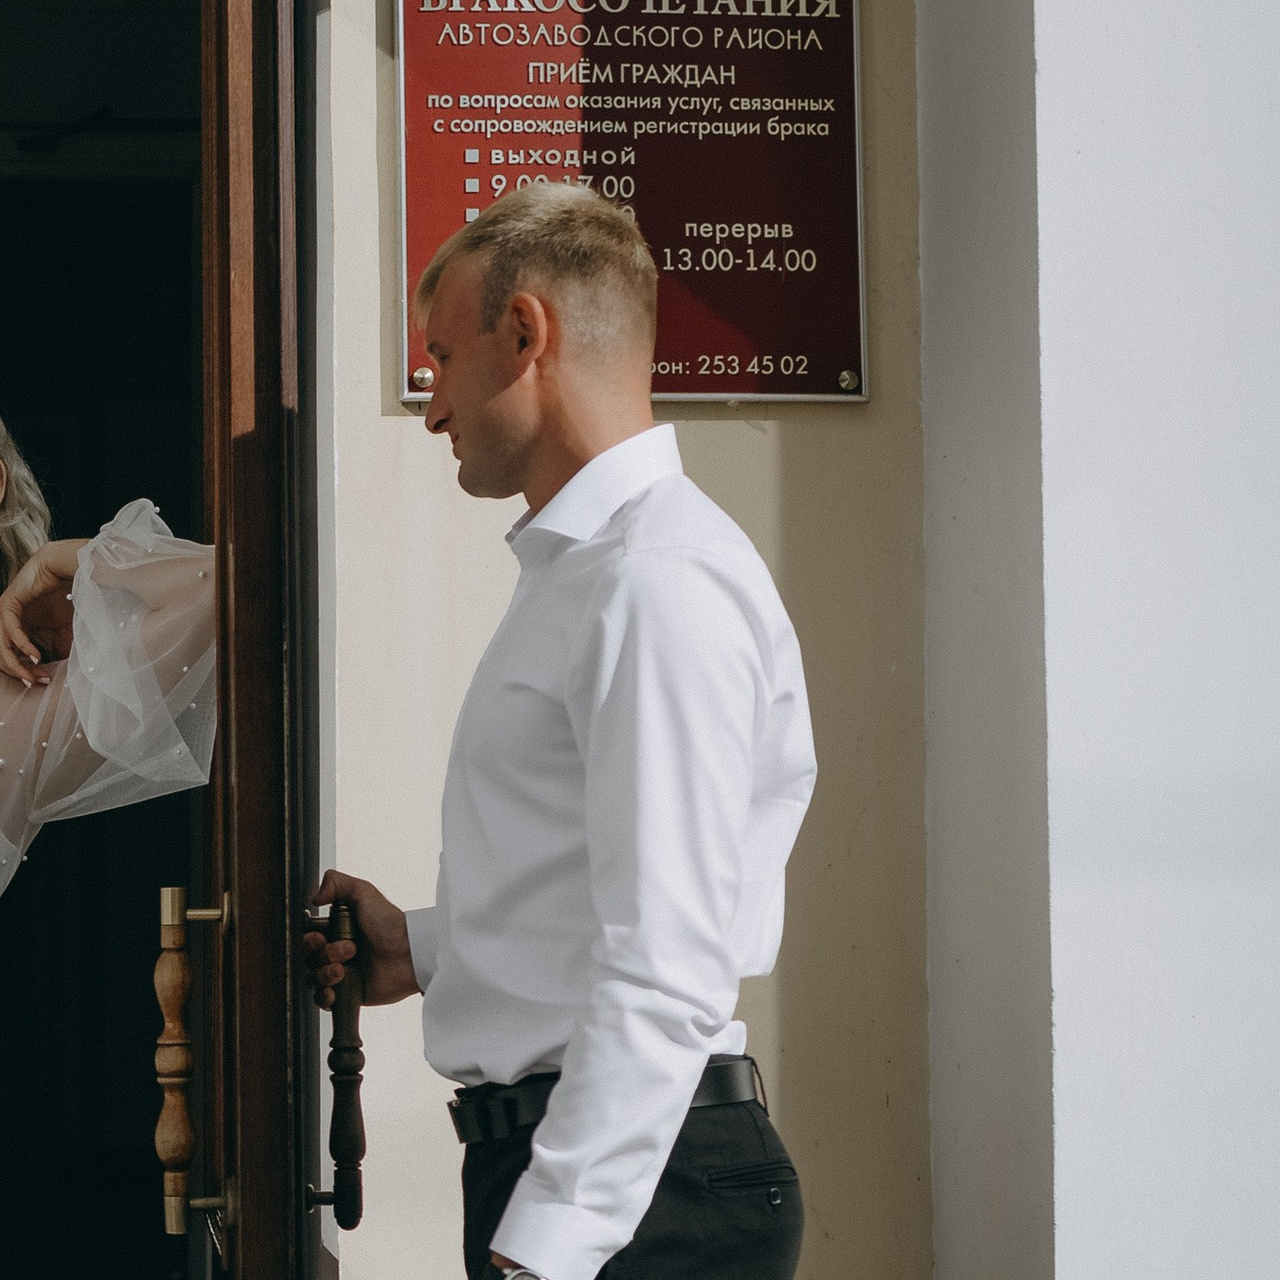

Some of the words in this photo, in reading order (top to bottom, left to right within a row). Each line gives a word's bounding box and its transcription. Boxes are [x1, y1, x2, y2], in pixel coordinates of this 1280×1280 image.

[438, 23, 703, 47] АВТОЗАВОДСКОГО
[714, 24, 823, 51] РАЙОНА
[529, 60, 613, 83] ПРИЁМ
[621, 63, 735, 88] ГРАЖДАН
[428, 94, 453, 108] по
[460, 94, 560, 113] вопросам
[565, 94, 662, 111] оказания
[668, 97, 722, 115] услуг,
[730, 98, 834, 111] связанных
[434, 120, 444, 132] с
[450, 118, 628, 138] сопровождением
[634, 121, 760, 139] регистрации
[767, 117, 828, 138] брака
[492, 147, 635, 167] выходной
[686, 223, 793, 244] перерыв
[663, 248, 816, 271] 13.00-14.00
[698, 355, 739, 374] 253
[747, 356, 773, 374] 45
[781, 356, 807, 374] 02
